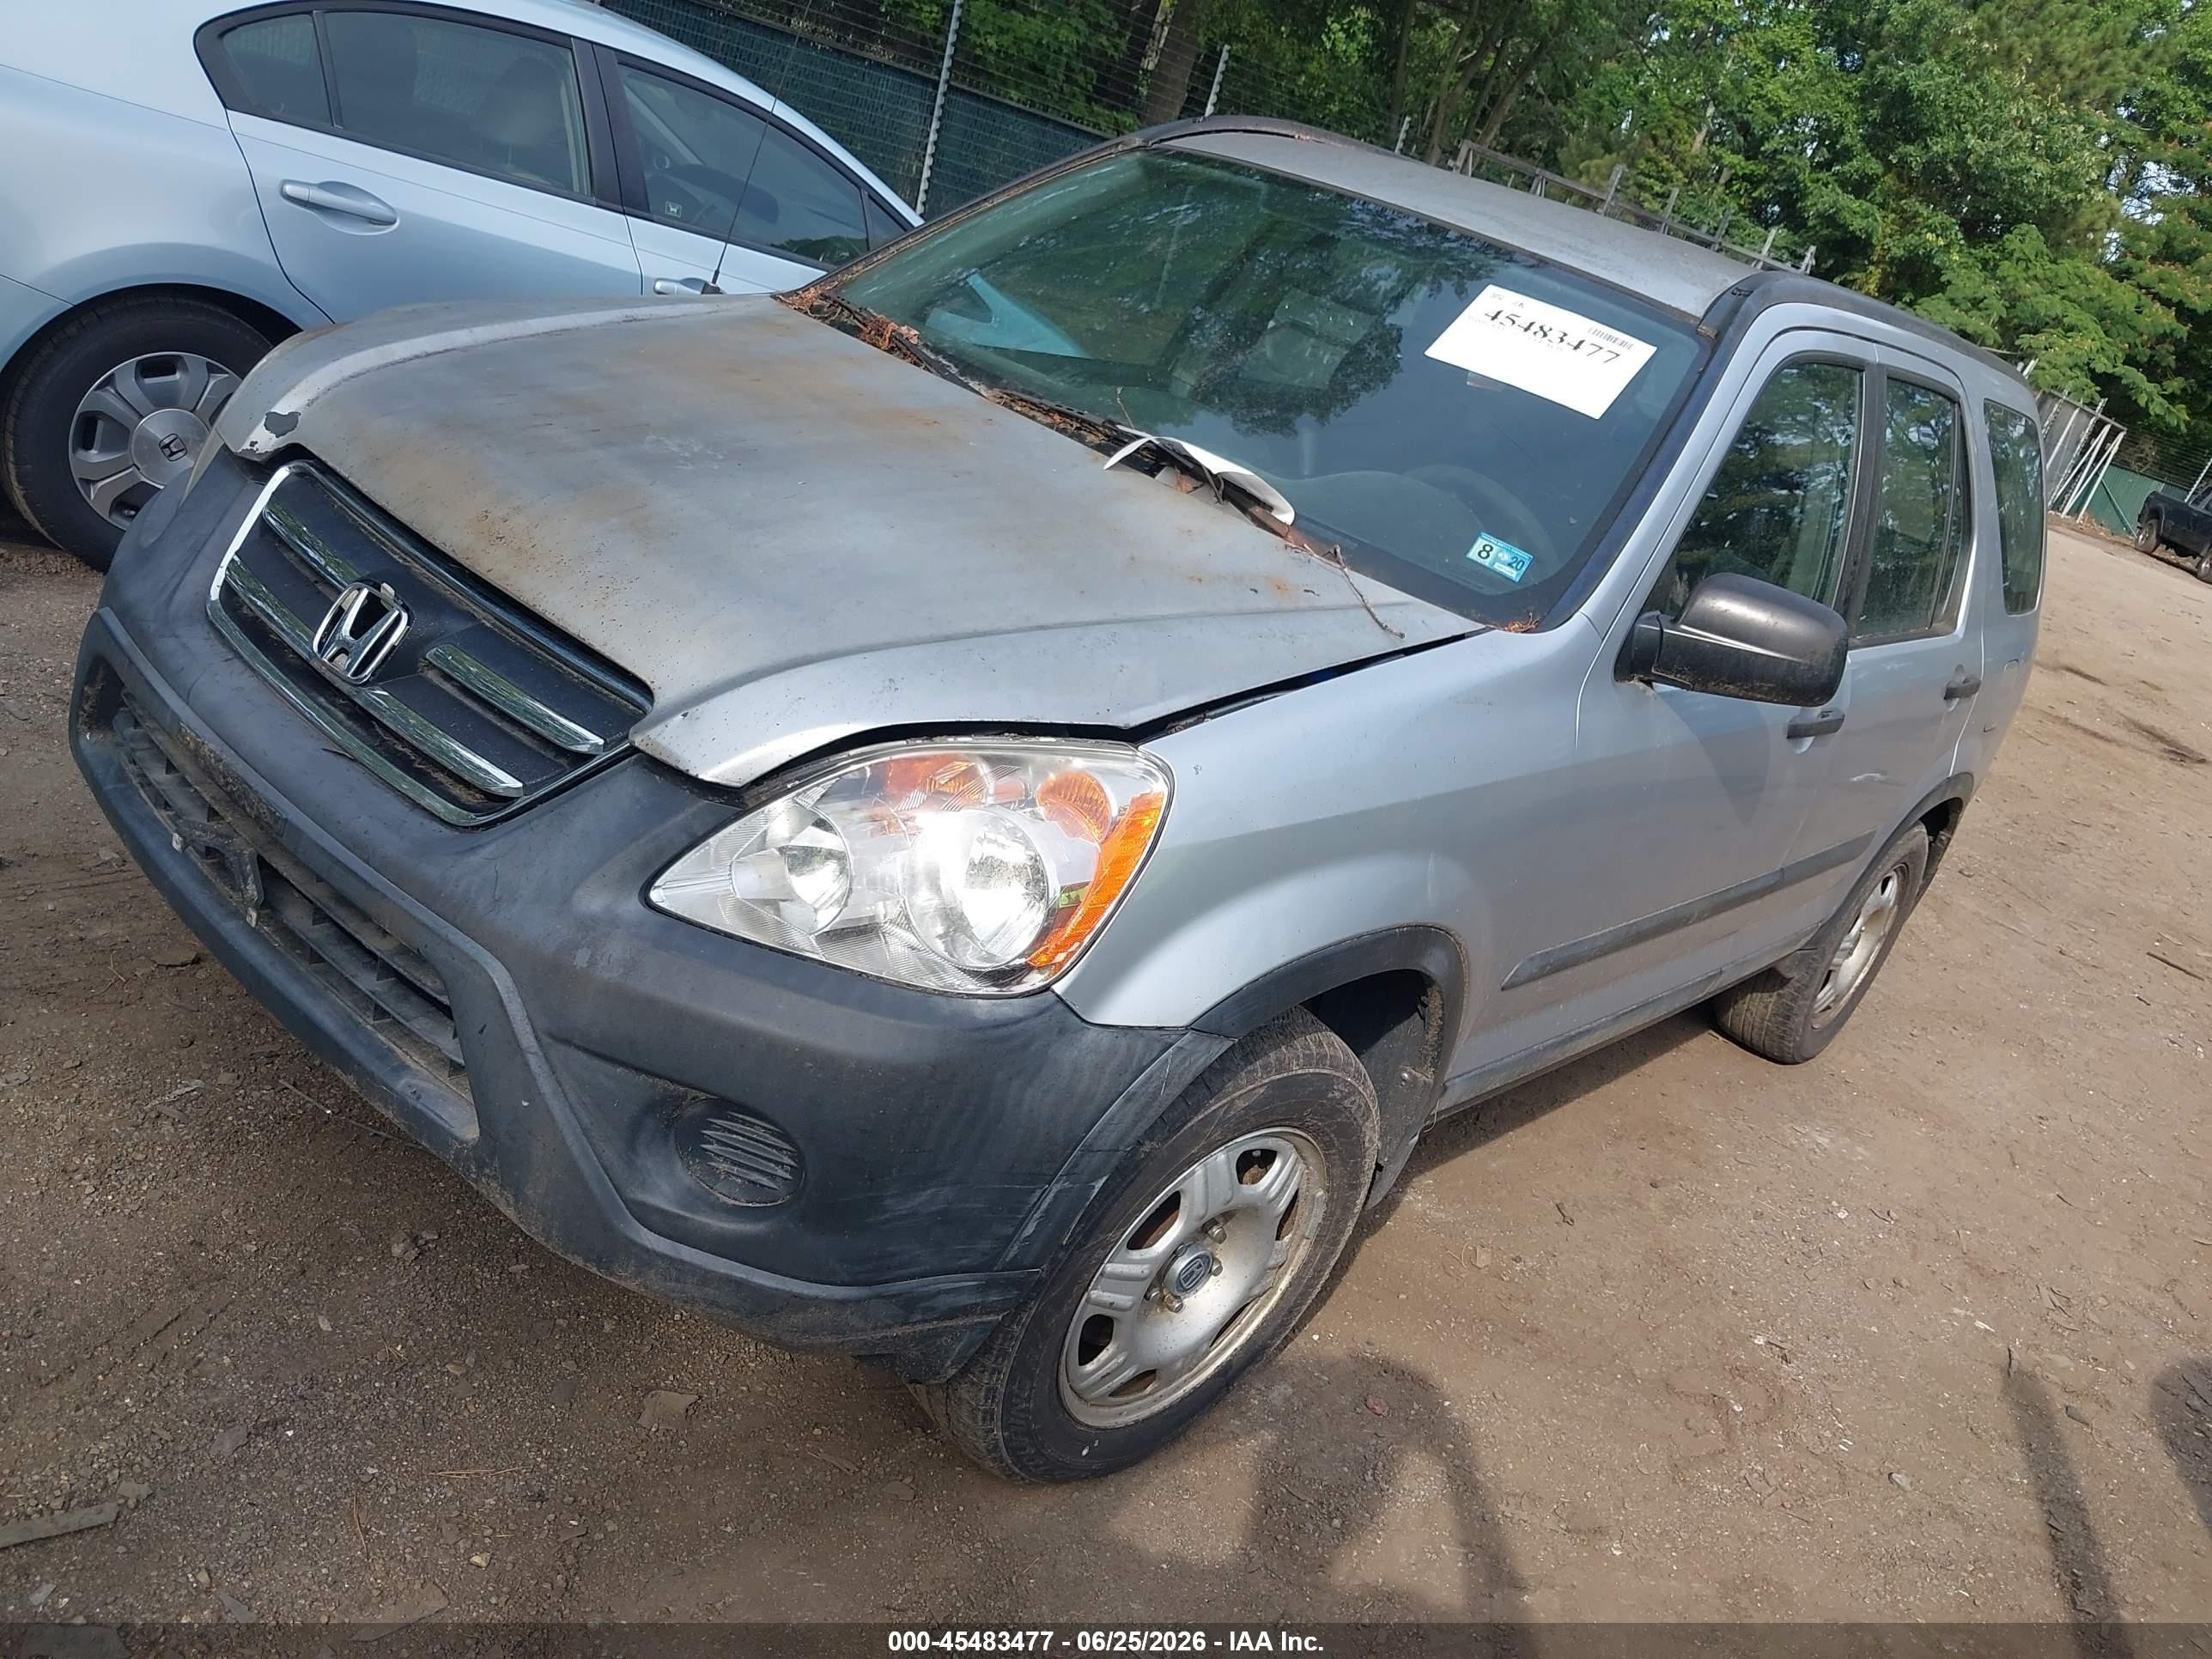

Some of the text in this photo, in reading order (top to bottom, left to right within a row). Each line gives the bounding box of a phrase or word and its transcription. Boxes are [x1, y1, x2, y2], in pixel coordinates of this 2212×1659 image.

[1484, 309, 1621, 364] 45483477
[1477, 544, 1494, 560] 8
[1507, 555, 1525, 571] 20
